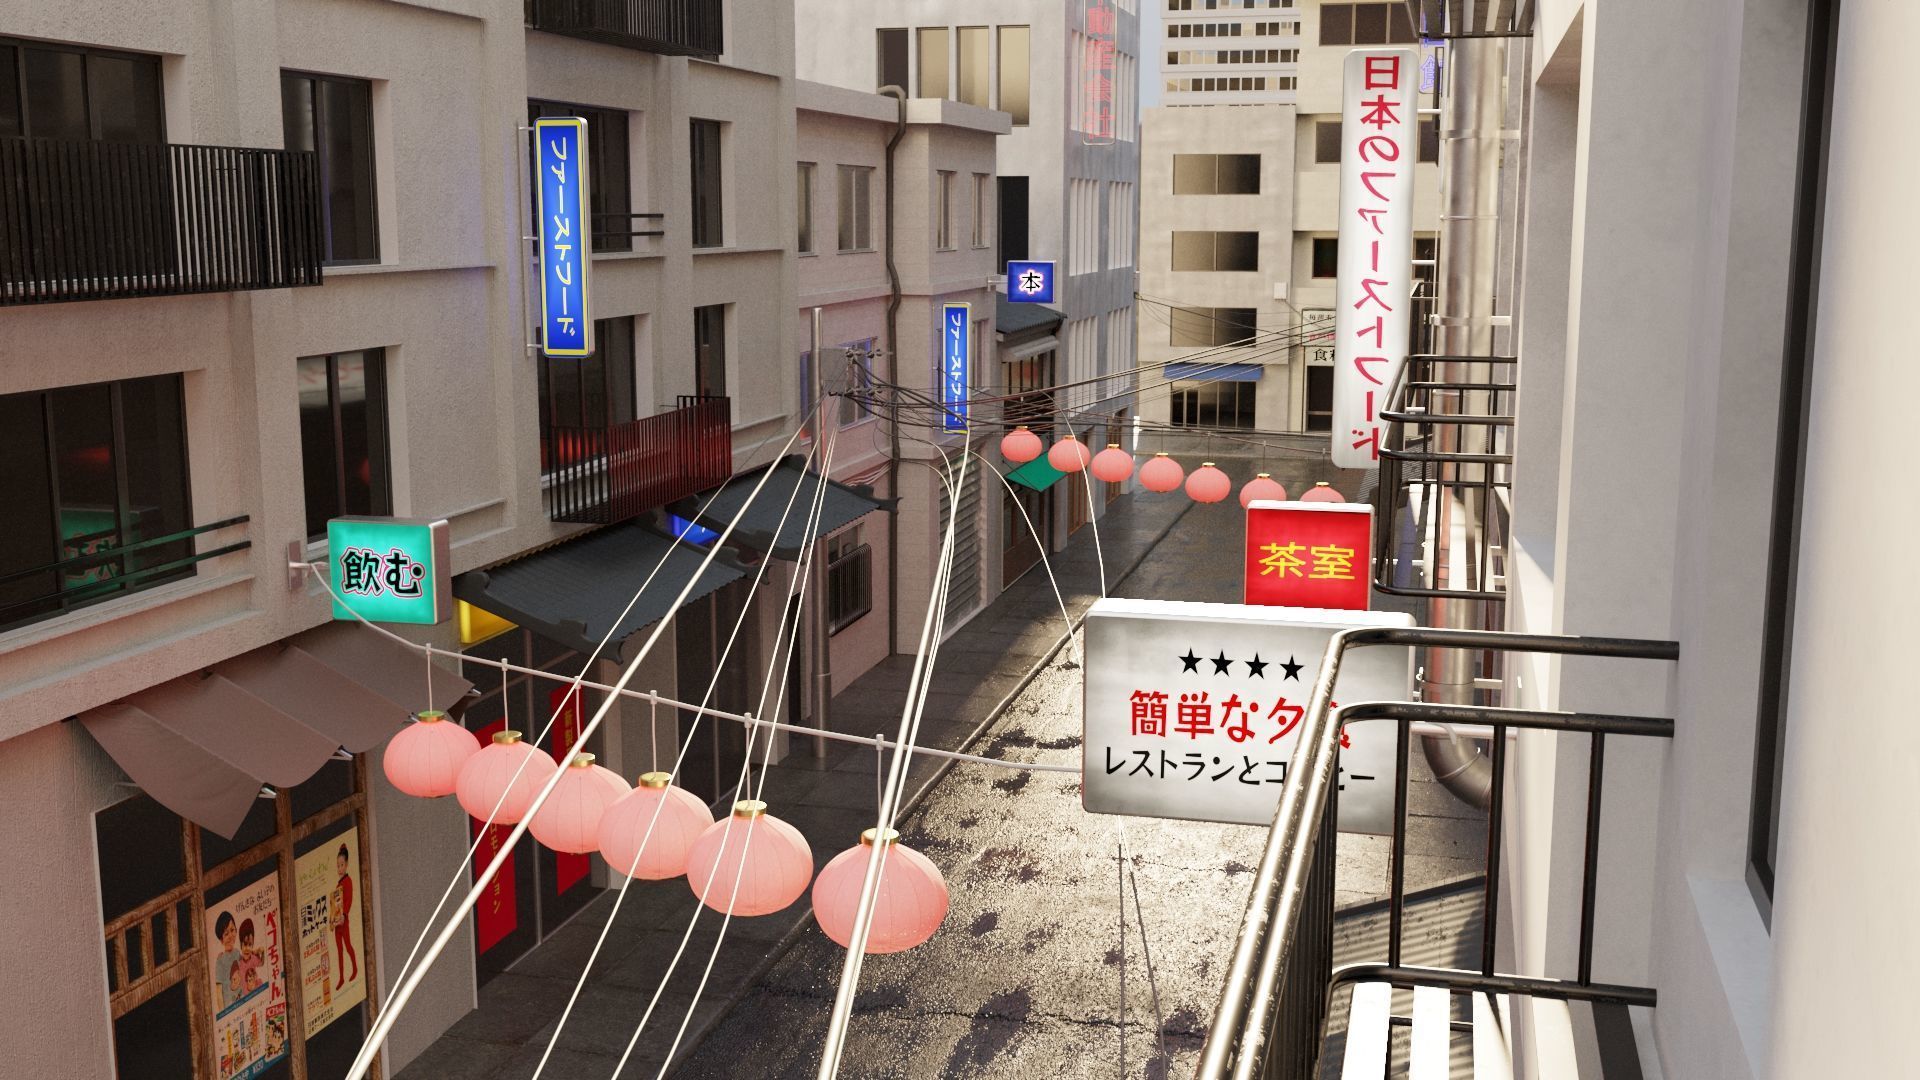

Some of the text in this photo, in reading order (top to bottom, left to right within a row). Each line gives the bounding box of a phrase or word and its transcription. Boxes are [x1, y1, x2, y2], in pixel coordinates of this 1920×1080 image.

[550, 136, 576, 337] ファーストフード
[1021, 271, 1041, 292] 本
[342, 549, 423, 596] 飲む
[1258, 541, 1356, 580] 茶室
[1129, 690, 1352, 750] 簡単な夕
